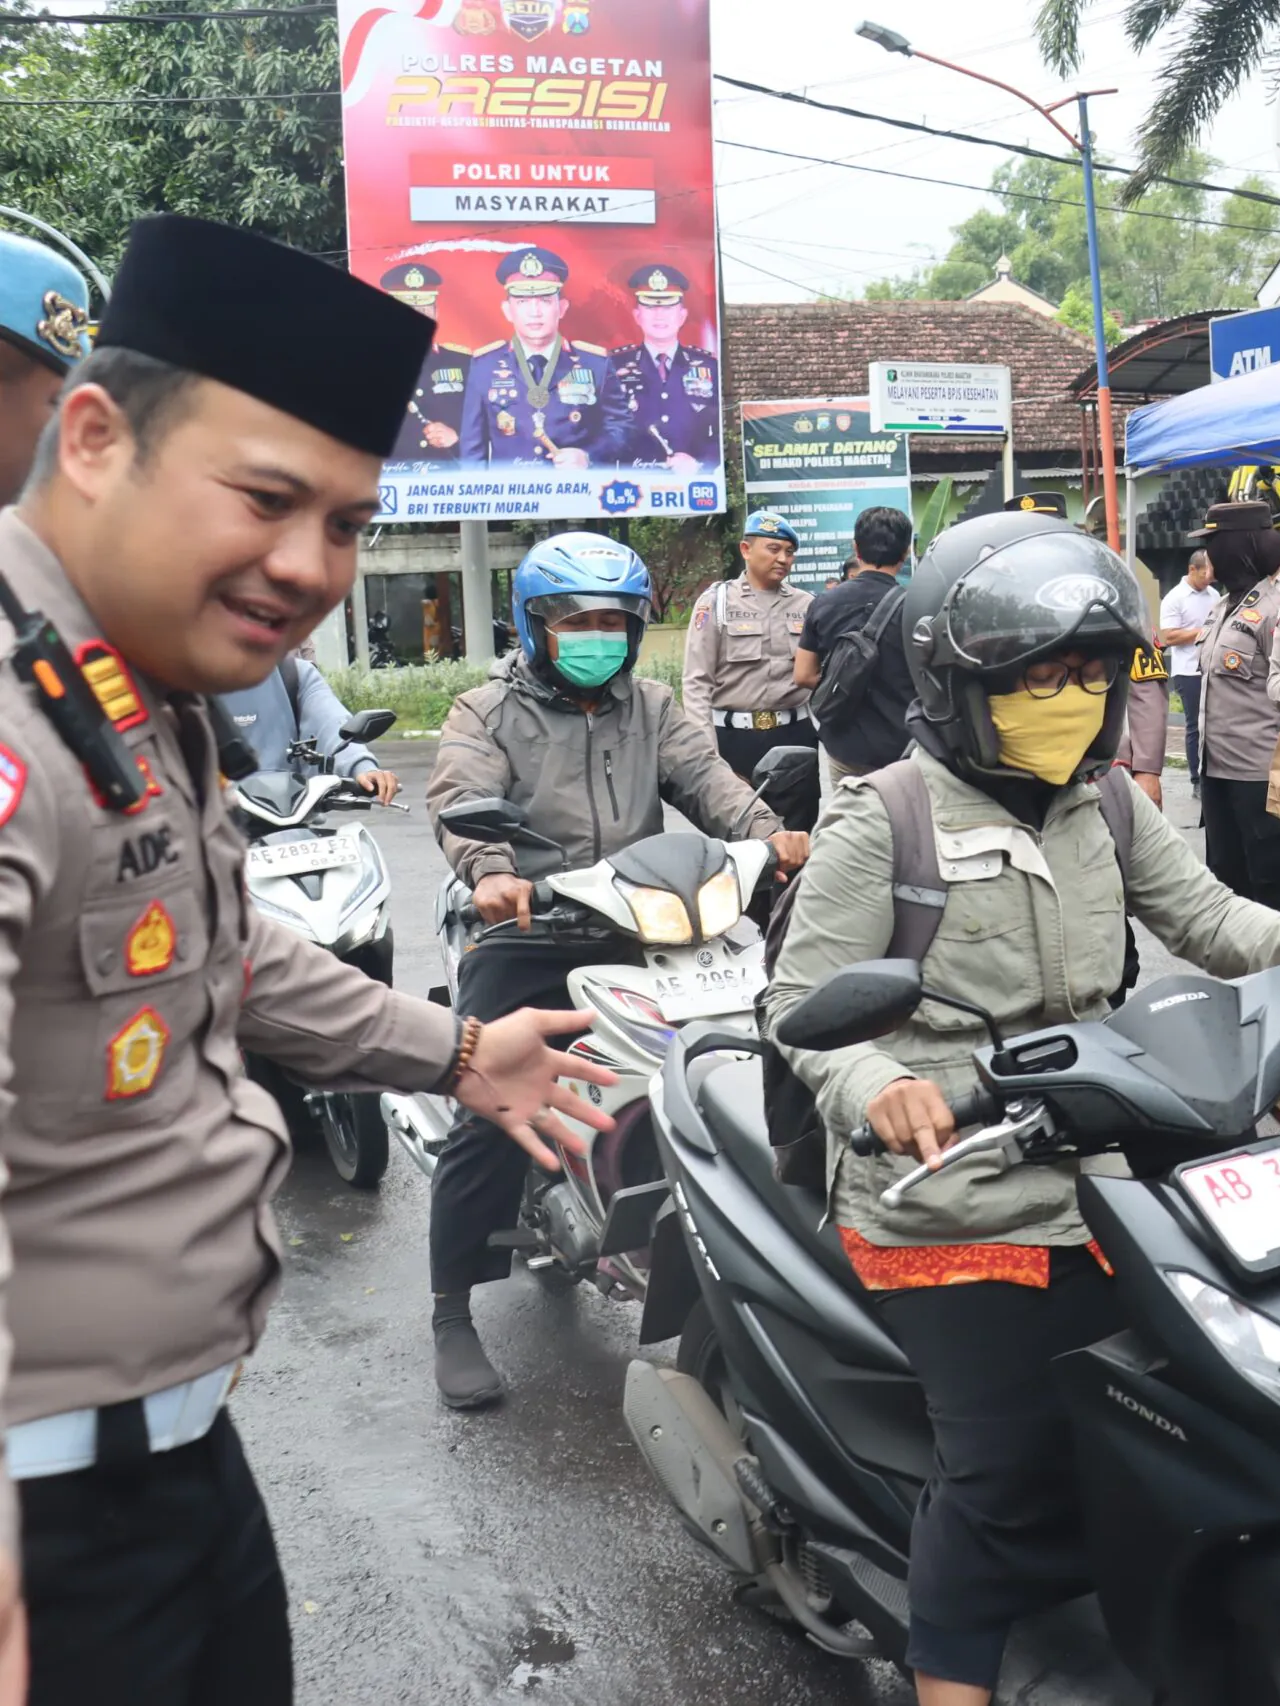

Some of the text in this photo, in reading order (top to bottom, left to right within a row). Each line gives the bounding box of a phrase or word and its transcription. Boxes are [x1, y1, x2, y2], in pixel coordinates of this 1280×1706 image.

[402, 53, 663, 77] POLRES MAGETAN
[386, 75, 668, 120] PRESISI
[453, 163, 611, 182] POLRI UNTUK
[456, 195, 610, 213] MASYARAKAT
[1229, 345, 1272, 377] ATM
[887, 386, 999, 401] MELAYANI PESERTA BPJS KESEHATAN
[753, 440, 898, 458] SELAMAT DATANG
[760, 454, 892, 469] DI MAKO POLRES MAGETAN
[407, 483, 592, 497] JANGAN SAMPAI HILANG ARAH,
[651, 492, 684, 507] BRI
[692, 486, 714, 499] BRI
[407, 502, 540, 515] BRI TERBUKTI MURAH
[728, 610, 757, 618] TEDY
[116, 826, 180, 883] ADE
[250, 838, 349, 863] AE 2892 EZ
[654, 976, 687, 999] AE
[1148, 991, 1211, 1013] HONDA
[1203, 1169, 1252, 1208] AB
[1105, 1384, 1189, 1442] HONDA
